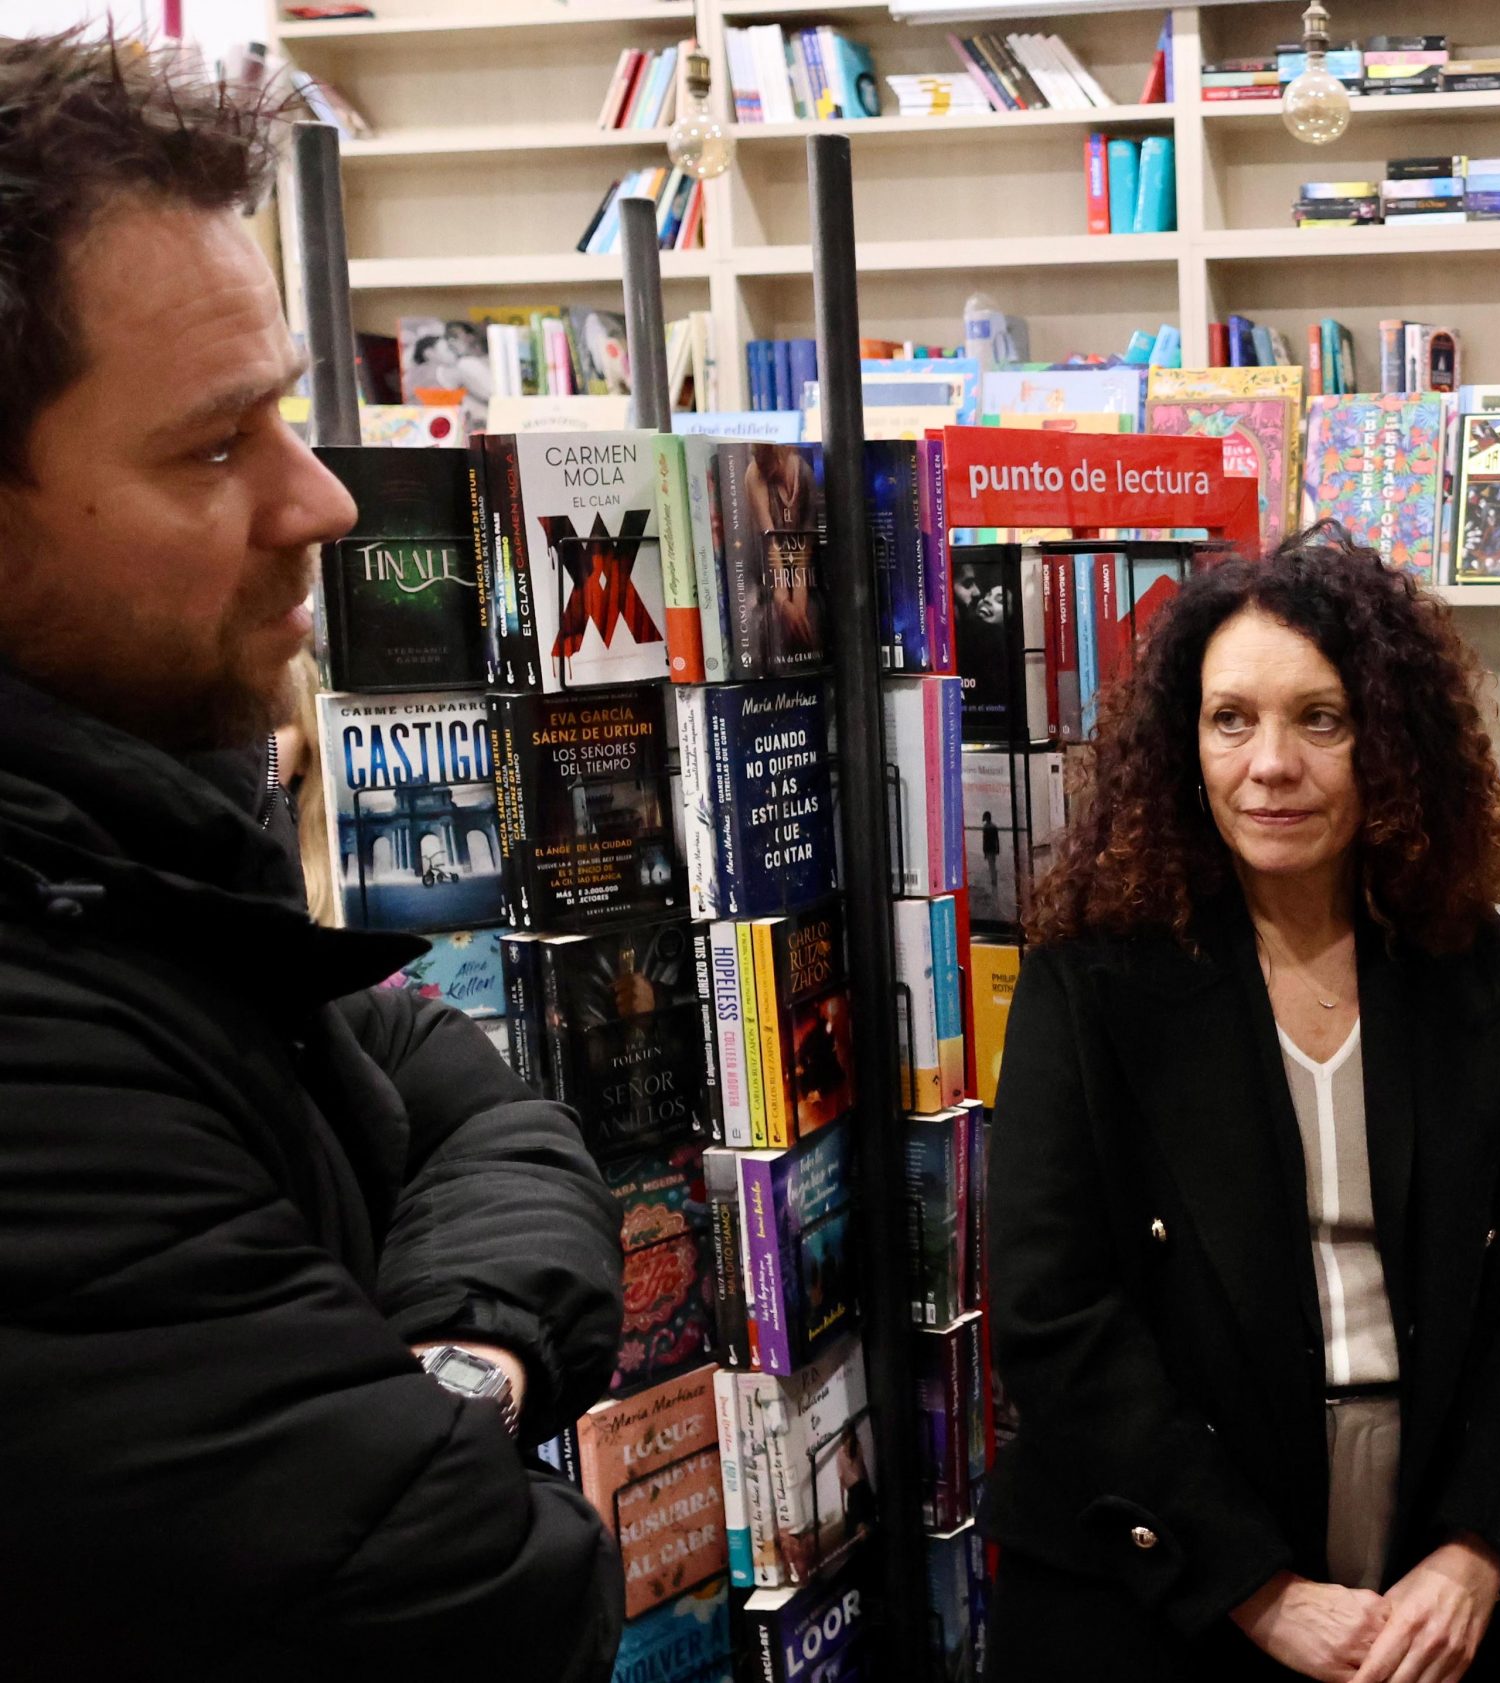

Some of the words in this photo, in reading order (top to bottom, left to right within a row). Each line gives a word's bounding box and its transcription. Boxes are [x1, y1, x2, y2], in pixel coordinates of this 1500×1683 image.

[545, 445, 637, 466] CARMEN
[469, 468, 478, 506] URTURI
[564, 467, 625, 487] MOLA
[728, 454, 737, 496] GRAMONT
[910, 455, 918, 494] KELLEN
[934, 454, 942, 494] KELLEN
[969, 461, 1063, 498] punto
[1071, 459, 1106, 493] de
[1117, 459, 1209, 495] lectura
[573, 497, 586, 508] EL
[589, 495, 620, 507] CLAN
[472, 511, 479, 523] DE
[736, 560, 746, 602] CHRISTIE
[916, 564, 922, 574] LA
[917, 576, 923, 588] EN
[1058, 565, 1066, 597] VARGAS
[1102, 564, 1110, 593] LOWRY
[518, 572, 530, 616] CLAN
[479, 608, 487, 626] EVA
[738, 604, 749, 633] CASO
[918, 589, 926, 634] NOSOTROS
[522, 620, 532, 637] EL
[742, 637, 749, 647] EL
[341, 706, 397, 717] CARME
[404, 701, 487, 713] CHAPARRO
[550, 712, 577, 726] EVA
[581, 708, 634, 725] GARCÍA
[742, 695, 773, 717] María
[777, 690, 818, 711] Martínez
[532, 726, 577, 745] SÁENZ
[582, 726, 598, 742] DE
[603, 722, 653, 738] URTURI
[754, 730, 807, 753] CUANDO
[342, 719, 493, 790] CASTIGO
[491, 729, 501, 767] URTURI
[553, 748, 577, 762] LOS
[581, 742, 636, 759] SEÑORES
[494, 769, 502, 783] DE
[560, 762, 583, 776] DEL
[586, 758, 631, 774] TIEMPO
[745, 758, 764, 778] NO
[717, 775, 725, 803] CUANDO
[723, 764, 732, 801] ESTRELLAS
[723, 814, 734, 848] Martínez
[546, 845, 570, 855] ÁNGE
[590, 842, 599, 850] LA
[602, 839, 632, 849] CIUDAD
[725, 849, 735, 875] María
[694, 936, 706, 958] SILVA
[446, 974, 495, 1000] Kellen
[696, 961, 710, 998] LORENZO
[714, 947, 738, 1021] HOPELESS
[992, 973, 1015, 981] PHILIP
[992, 983, 1014, 992] ROTH
[611, 1046, 663, 1068] TOLKIEN
[723, 1031, 736, 1068] COLLEEN
[753, 1077, 761, 1110] CARLOS
[770, 1087, 779, 1118] CARLOS
[726, 1246, 737, 1294] MALDITO
[718, 1278, 726, 1300] CRUZ
[608, 1409, 649, 1430] María
[653, 1384, 706, 1418] Martínez
[626, 1554, 656, 1581] AL
[660, 1524, 717, 1565] CAER
[786, 1590, 862, 1677] LOOR
